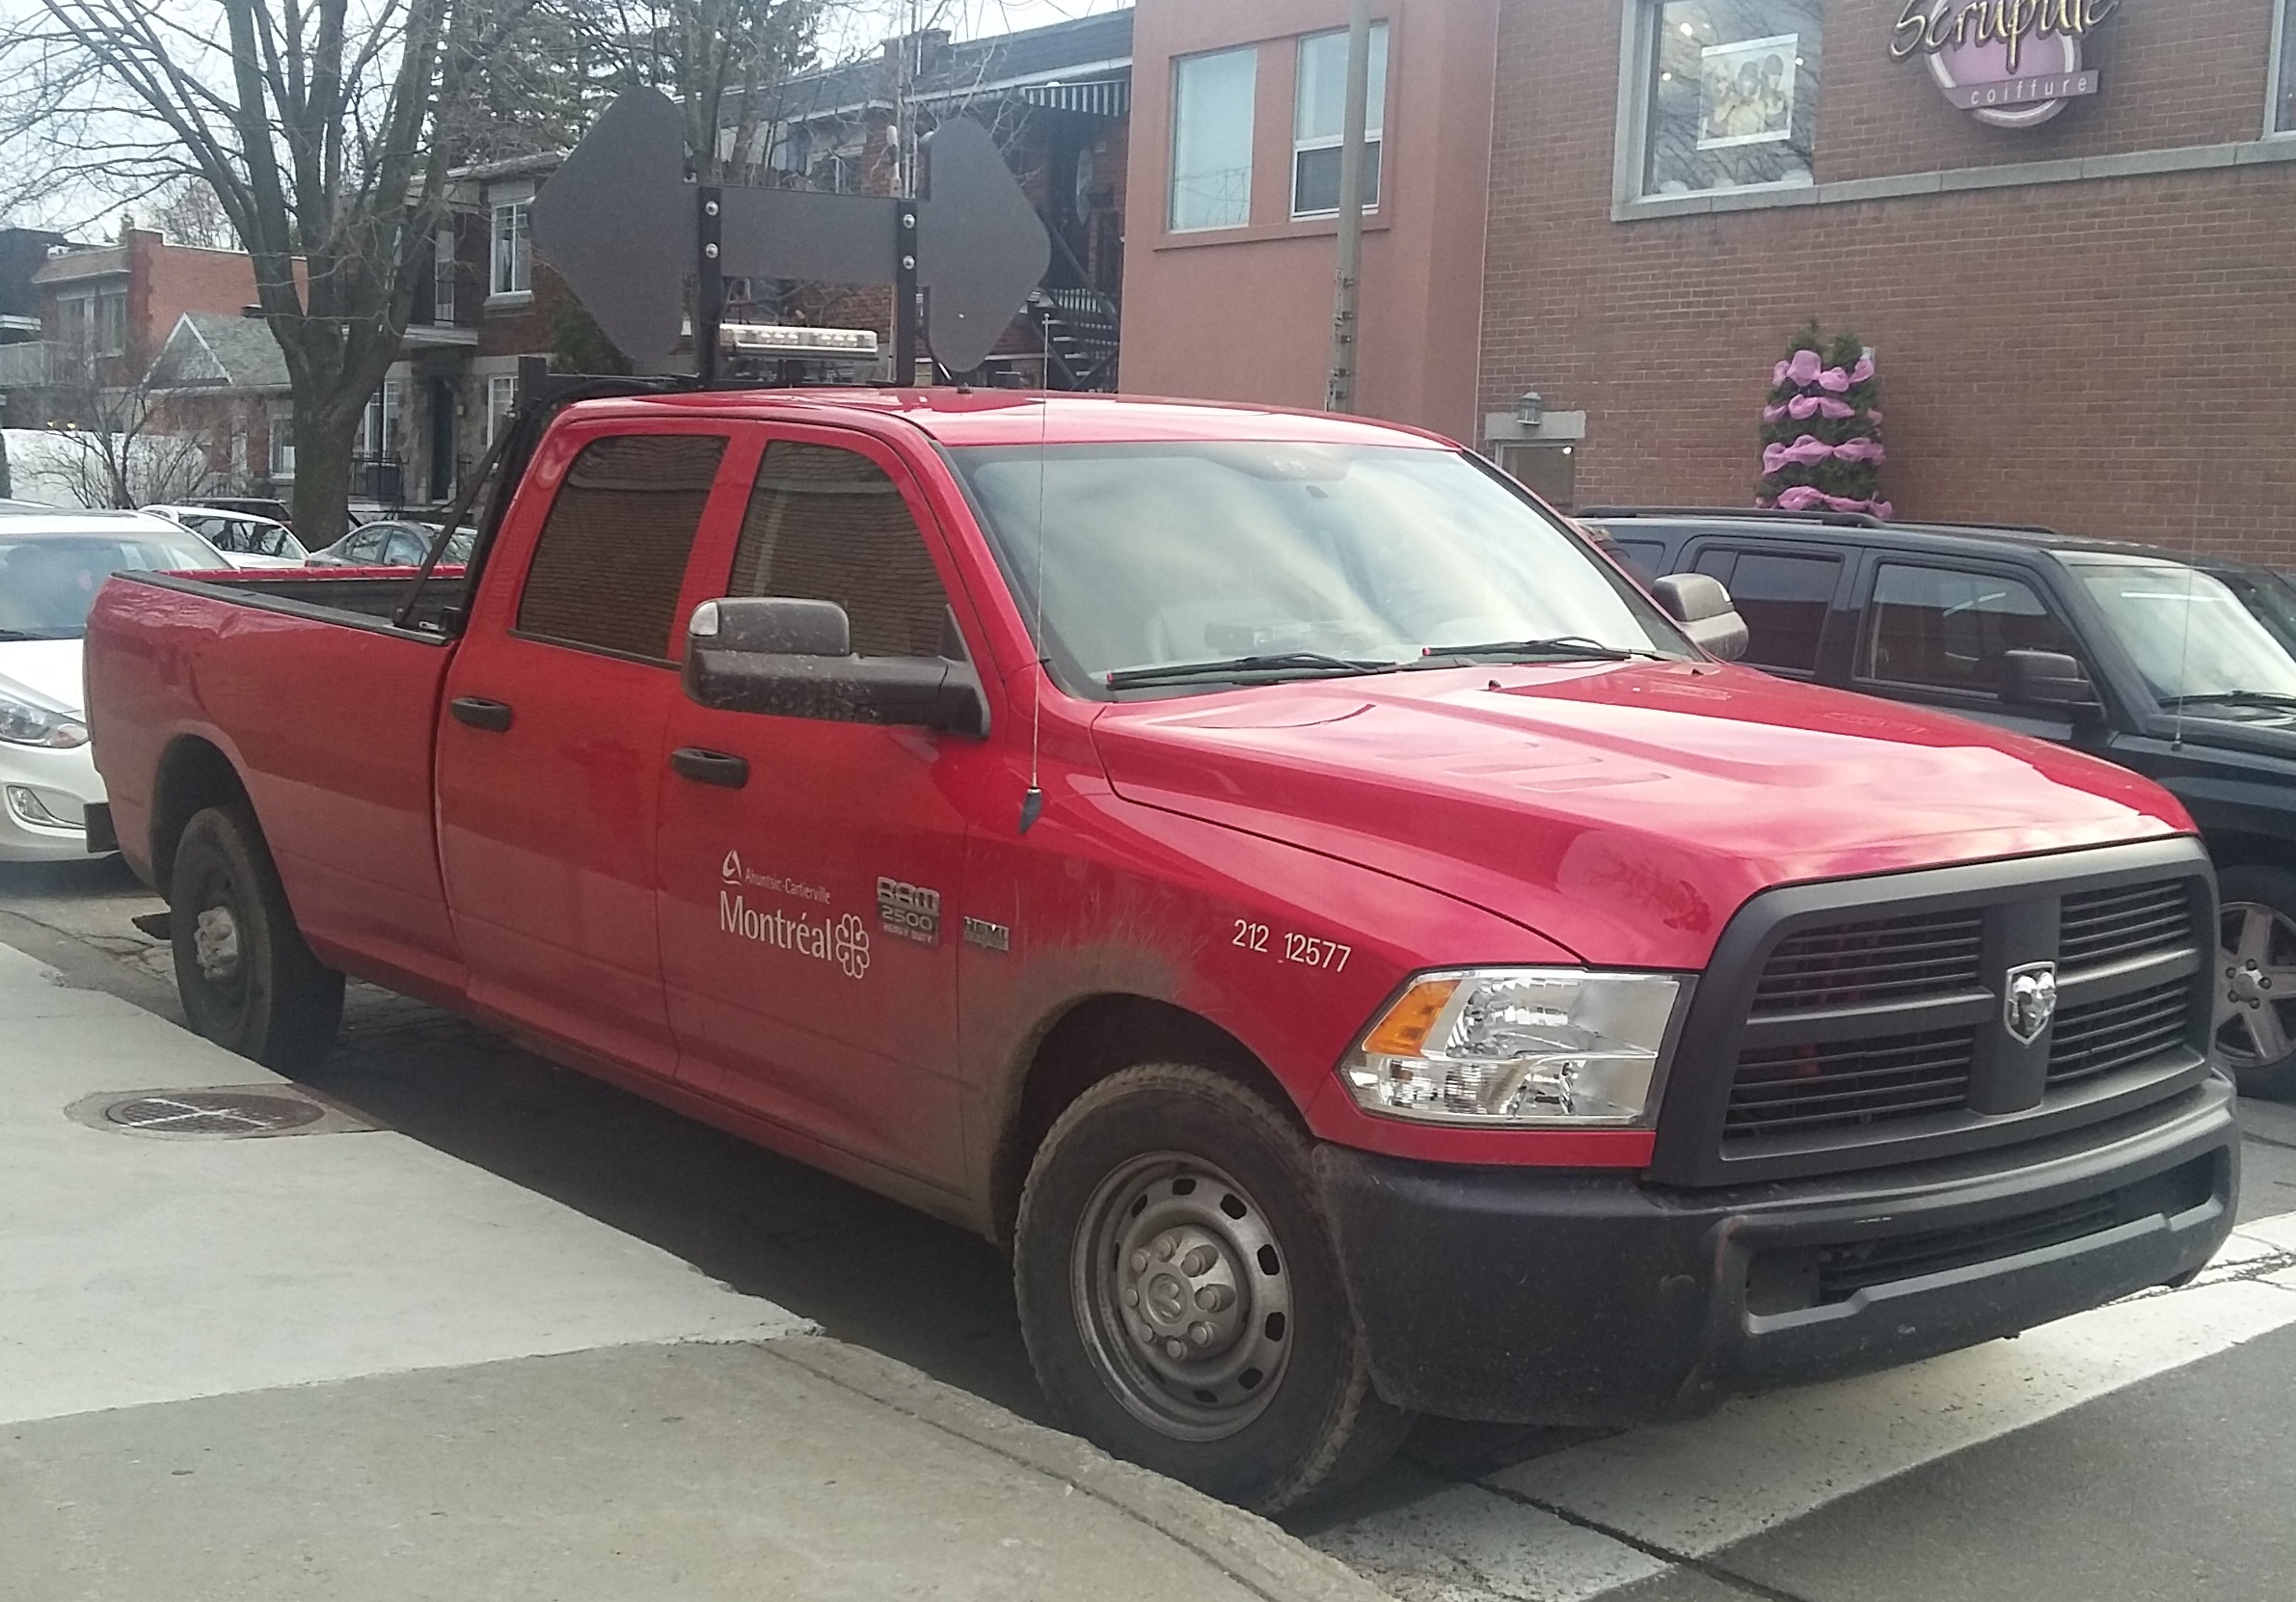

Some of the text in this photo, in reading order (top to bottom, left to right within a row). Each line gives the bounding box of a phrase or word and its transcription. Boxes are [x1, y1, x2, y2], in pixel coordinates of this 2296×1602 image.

[1971, 76, 2088, 105] coiffure
[877, 876, 940, 916] RAM
[720, 890, 832, 961] Montréal
[881, 904, 933, 931] 2500
[1232, 918, 1352, 973] 212 12577
